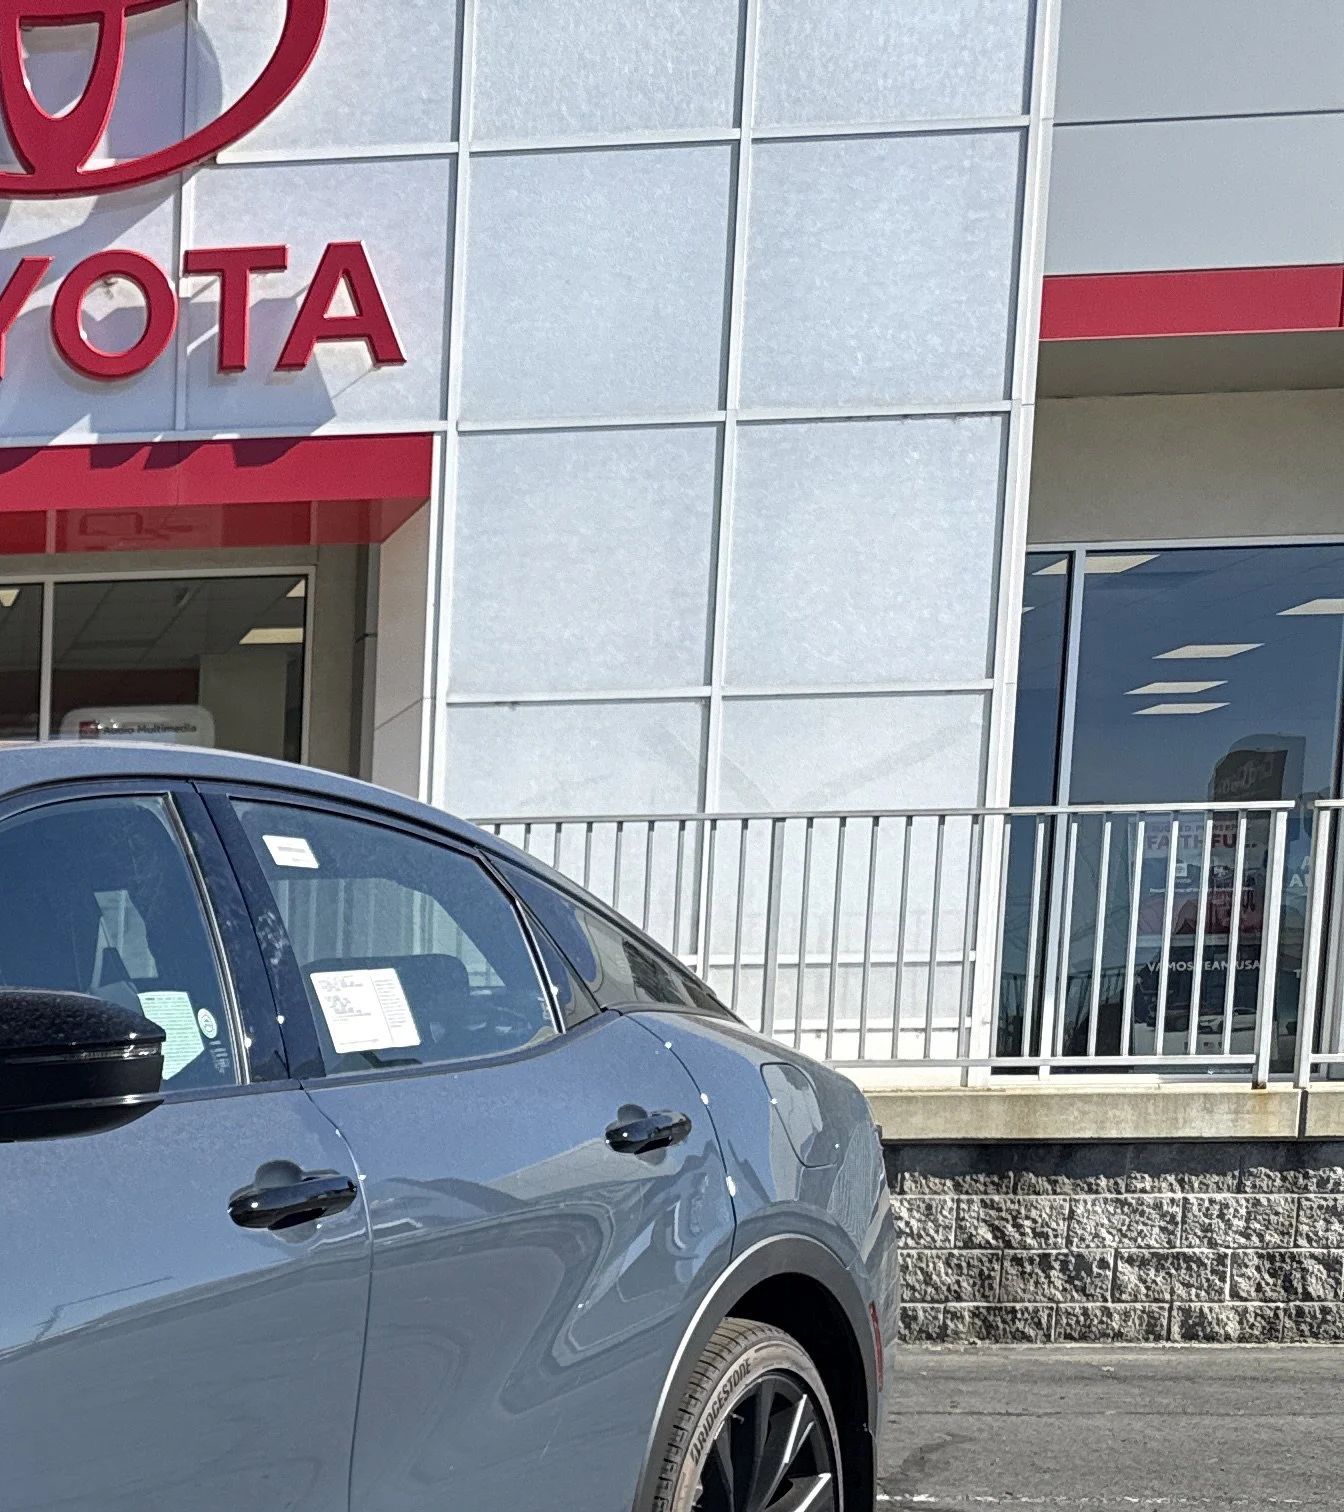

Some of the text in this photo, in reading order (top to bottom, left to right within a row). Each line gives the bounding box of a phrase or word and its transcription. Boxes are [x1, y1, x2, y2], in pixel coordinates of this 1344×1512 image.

[136, 722, 197, 734] Multimedia
[1235, 960, 1261, 971] USA
[690, 1358, 751, 1466] BRIDGESTONE
